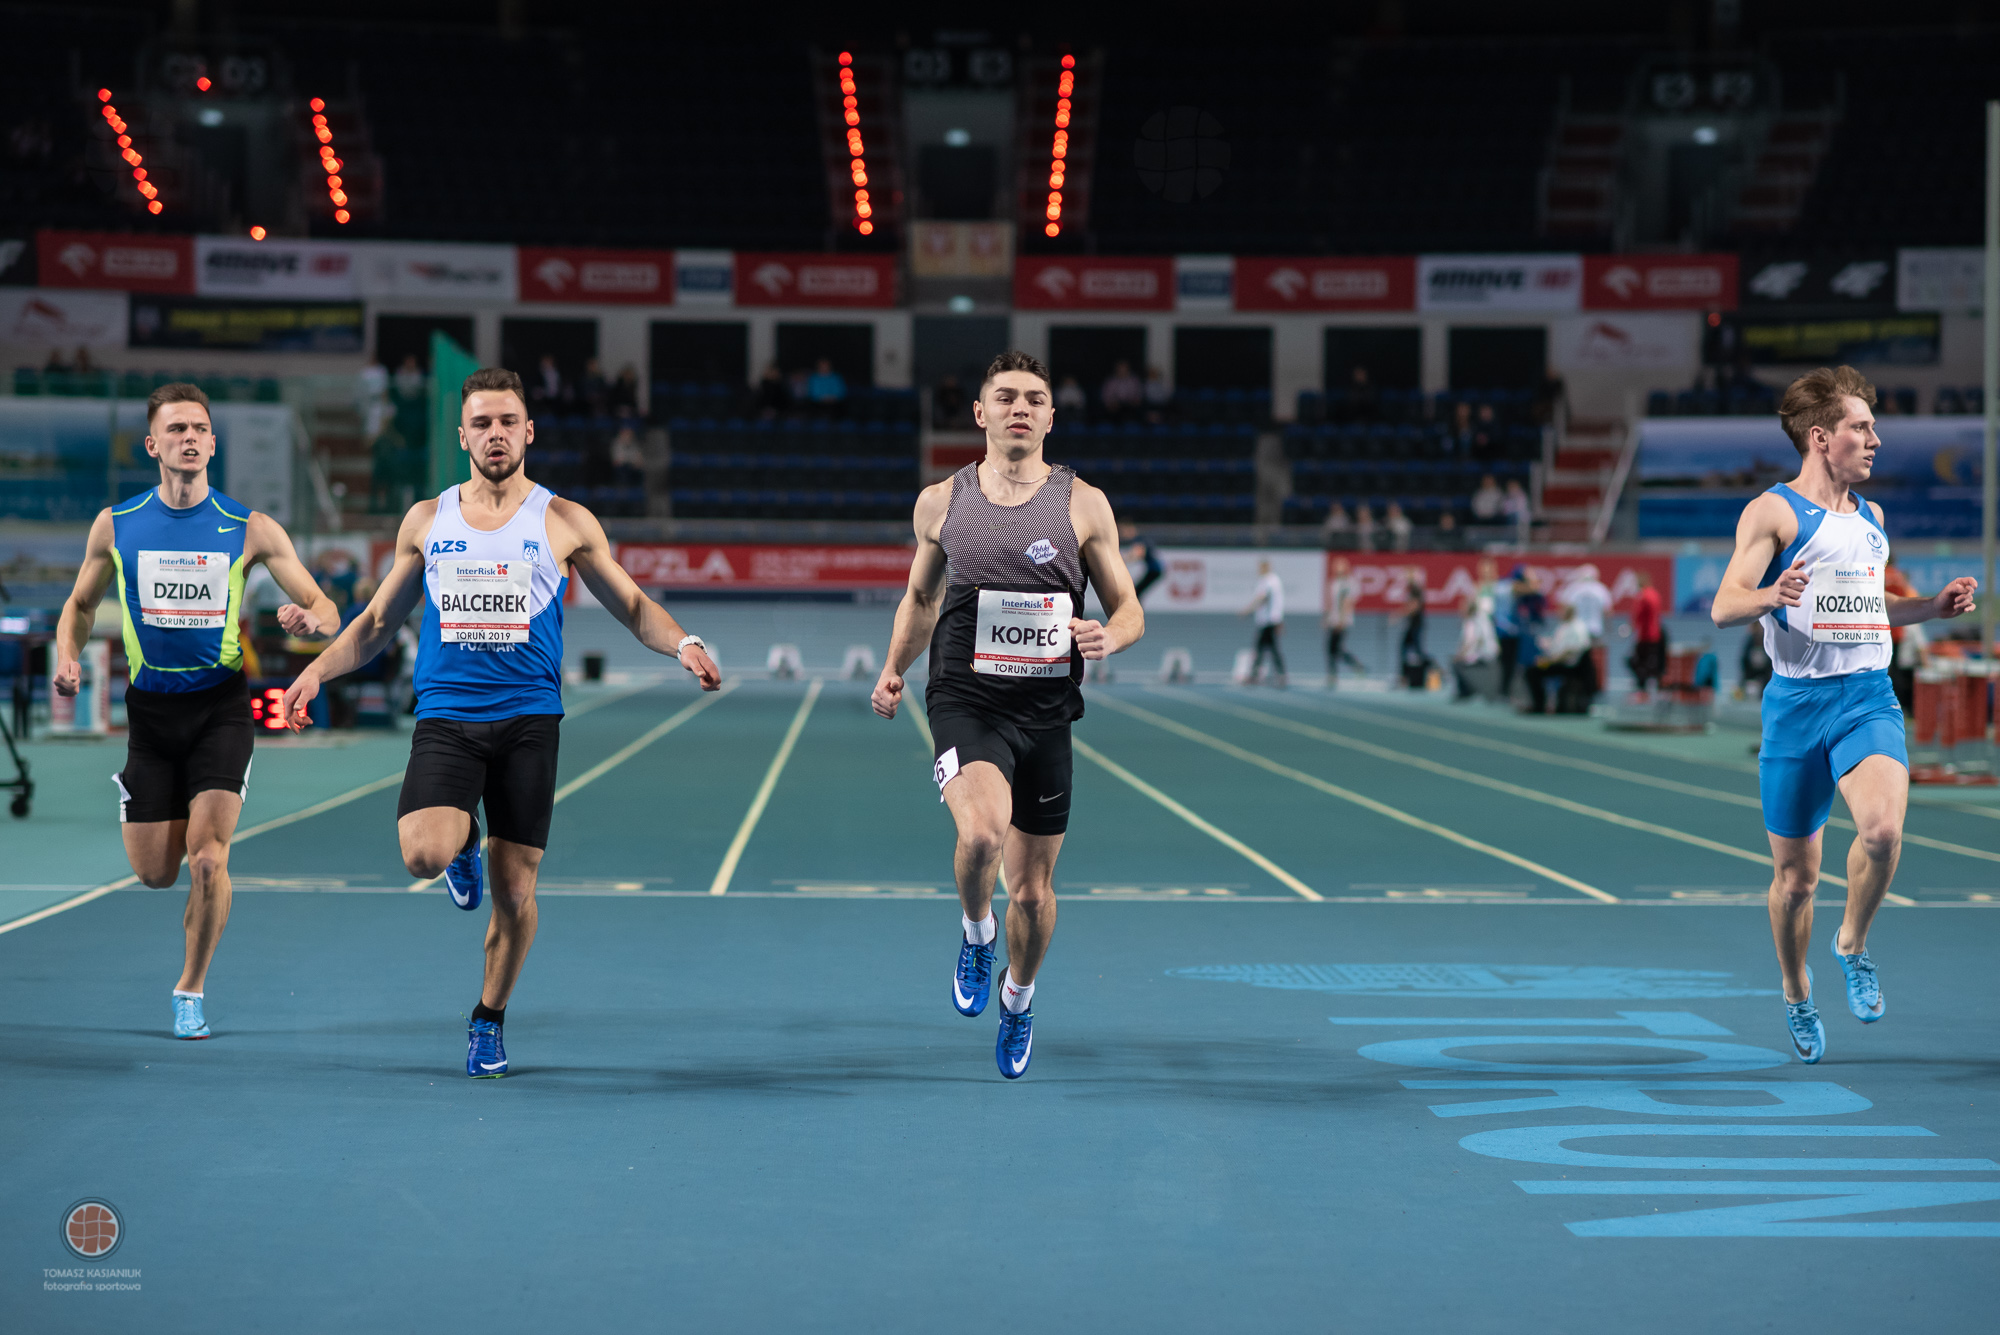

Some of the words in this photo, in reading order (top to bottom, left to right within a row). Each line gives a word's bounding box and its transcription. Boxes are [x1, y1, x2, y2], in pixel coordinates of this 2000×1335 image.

[430, 540, 467, 556] AZS
[159, 557, 196, 566] InterRisk
[457, 567, 496, 575] InterRisk
[154, 582, 212, 600] DZIDA
[442, 594, 527, 612] BALCEREK
[1002, 599, 1042, 608] InterRisk
[156, 616, 186, 626] TORUŃ
[188, 618, 210, 626] 2019
[456, 630, 485, 640] TORUŃ
[488, 632, 511, 640] 2019
[992, 624, 1059, 646] KOPEĆ
[1832, 630, 1861, 640] TORUŃ
[1863, 632, 1879, 640] 2019
[995, 664, 1028, 674] TORUŃ
[1031, 666, 1053, 675] 2019
